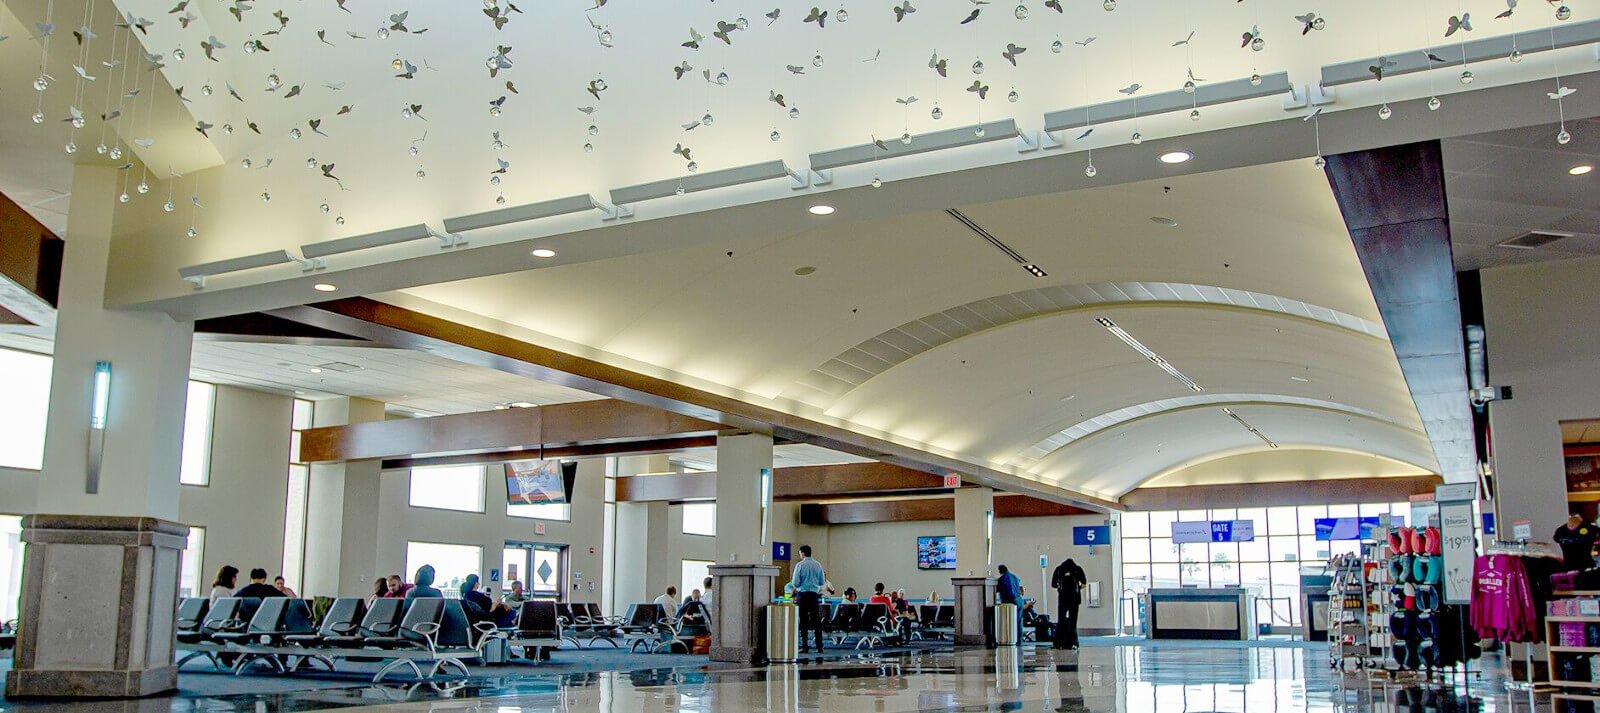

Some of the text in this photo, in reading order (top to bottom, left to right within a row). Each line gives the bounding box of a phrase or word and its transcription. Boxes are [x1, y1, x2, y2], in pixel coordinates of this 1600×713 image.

[946, 476, 957, 486] EXIT
[1212, 523, 1228, 533] GATE
[1087, 530, 1095, 541] 5
[1218, 532, 1224, 541] 5
[779, 545, 785, 556] 5
